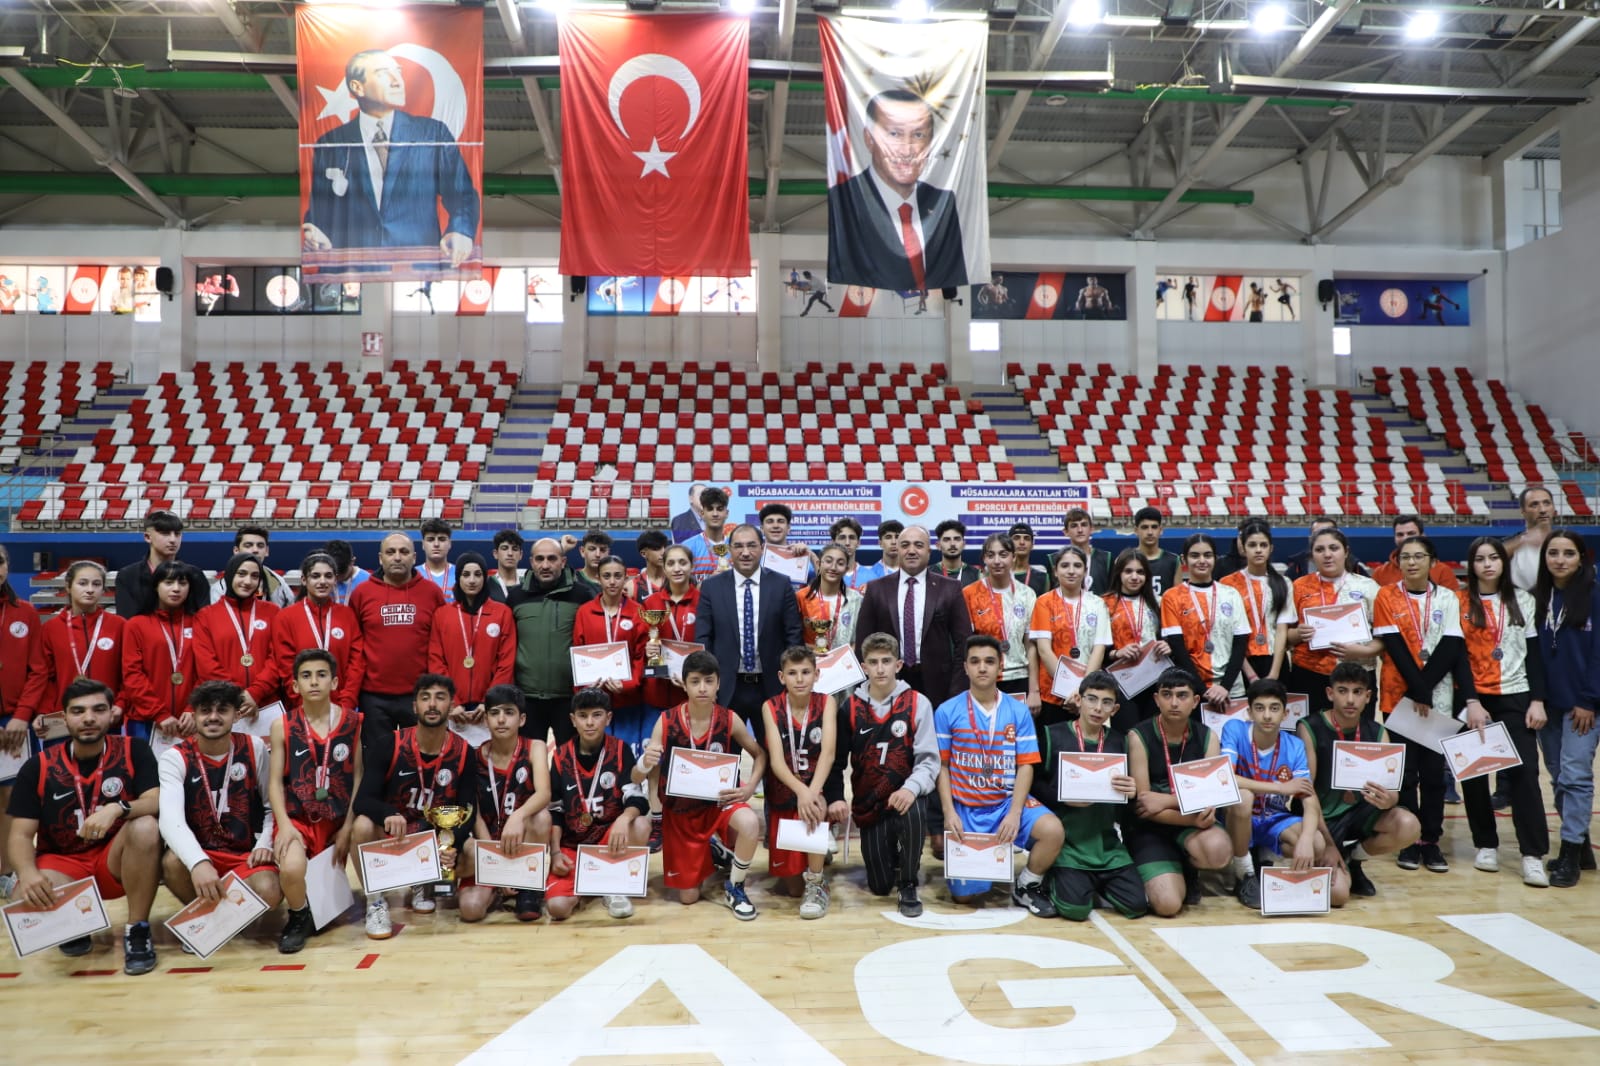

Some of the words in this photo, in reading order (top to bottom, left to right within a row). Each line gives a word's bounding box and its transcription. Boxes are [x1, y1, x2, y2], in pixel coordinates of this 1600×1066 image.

[747, 486, 816, 497] MÜSABAKALARA
[818, 487, 853, 497] KATILAN
[855, 487, 873, 497] TÜM
[960, 488, 1025, 497] MÜSABAKALARA
[1027, 488, 1061, 497] KATILAN
[1063, 488, 1080, 497] TÜM
[798, 503, 809, 511] VE
[810, 502, 876, 511] ANTRENÖRLERE
[974, 503, 1006, 511] SPORCU
[1007, 503, 1018, 511] VE
[983, 516, 1028, 526] BAŞARILAR
[381, 604, 416, 616] CHICAGO
[384, 615, 414, 626] BULLS
[876, 742, 889, 765] 7
[407, 787, 434, 811] 10
[504, 792, 516, 815] 9
